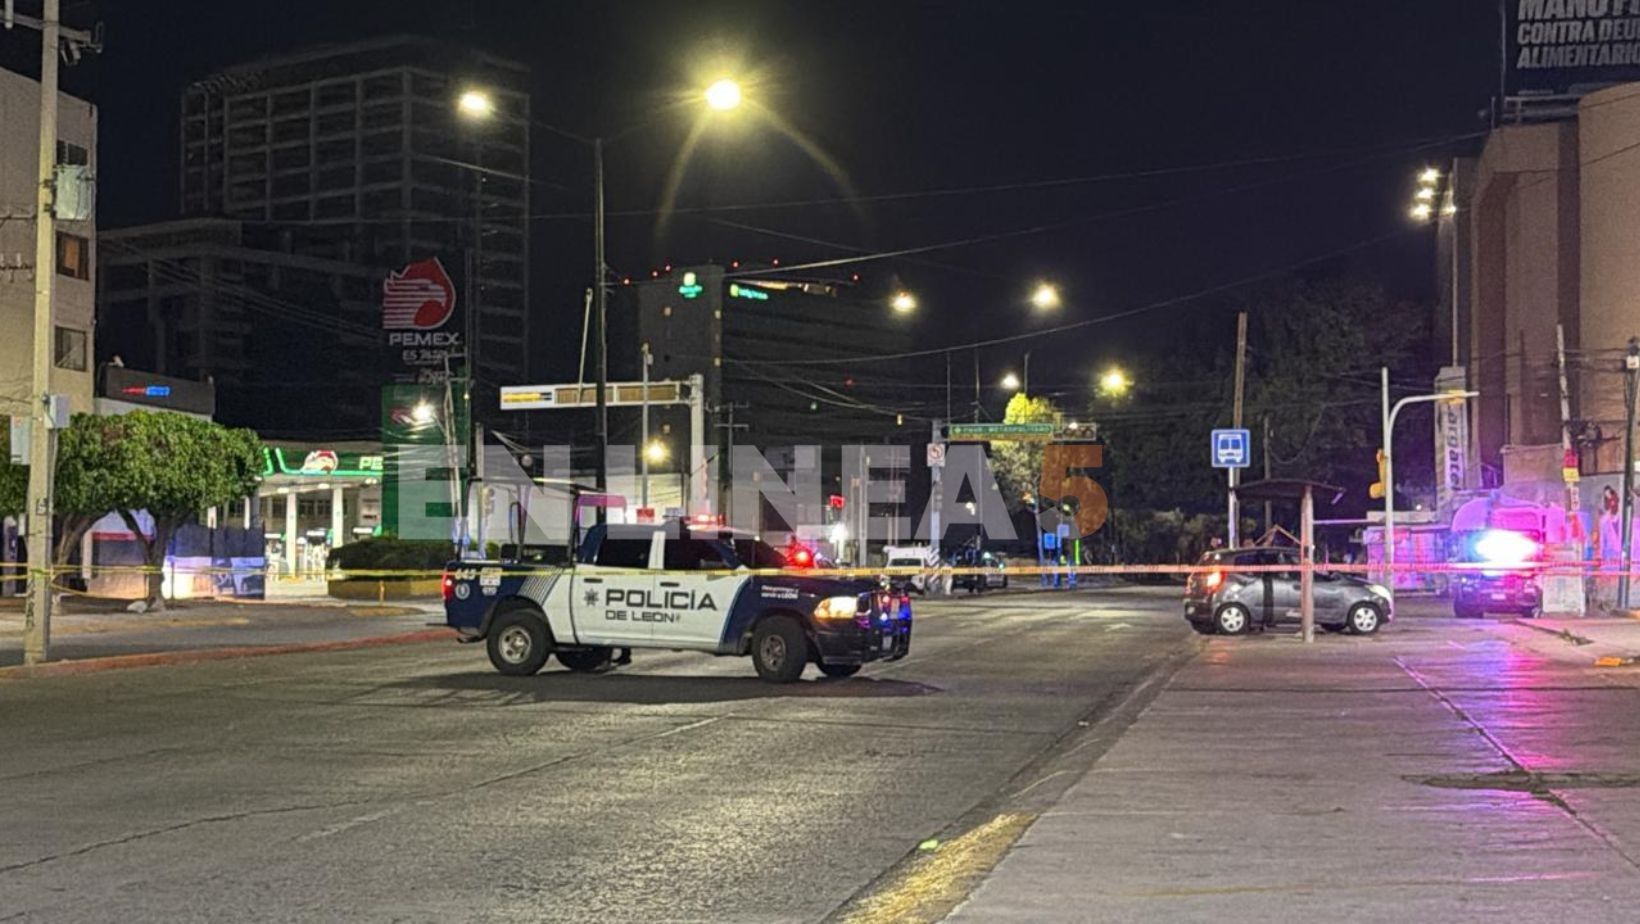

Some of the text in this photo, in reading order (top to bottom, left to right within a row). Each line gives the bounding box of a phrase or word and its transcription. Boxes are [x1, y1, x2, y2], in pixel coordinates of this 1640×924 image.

[1517, 18, 1640, 44] CONTRA DEU
[389, 332, 460, 346] PEMEX
[605, 588, 718, 612] POLICÍA
[605, 610, 628, 621] DE
